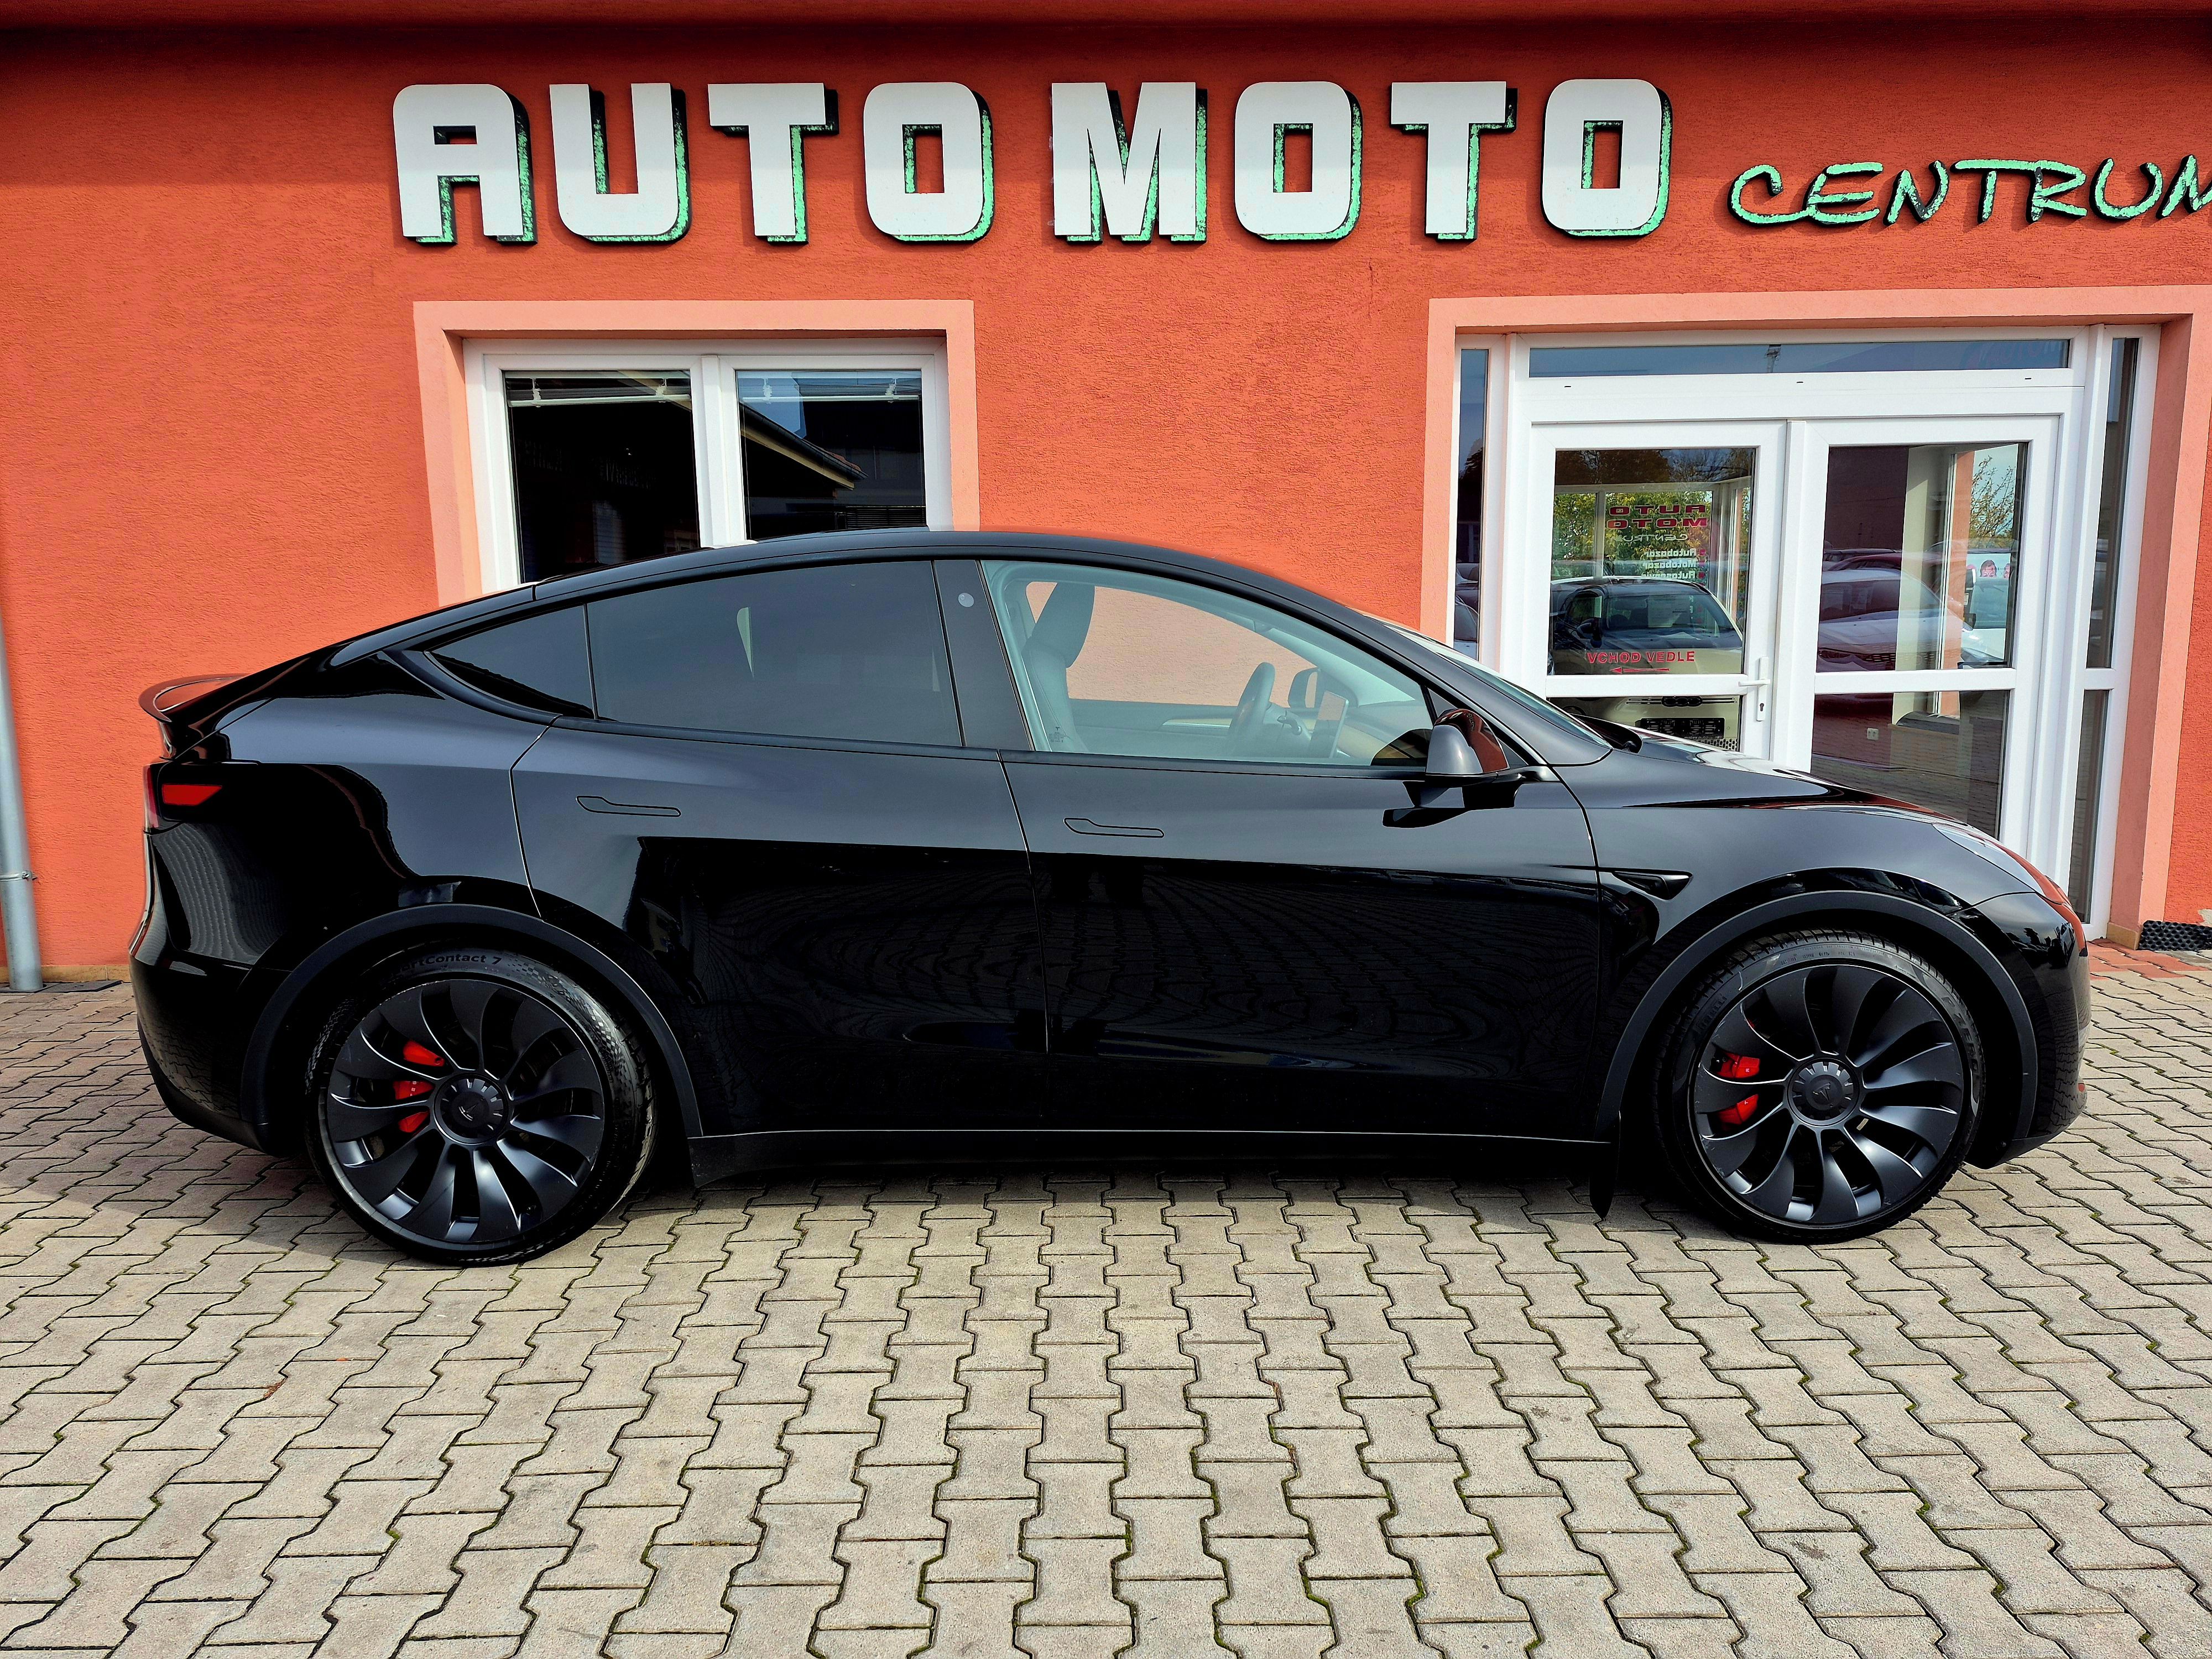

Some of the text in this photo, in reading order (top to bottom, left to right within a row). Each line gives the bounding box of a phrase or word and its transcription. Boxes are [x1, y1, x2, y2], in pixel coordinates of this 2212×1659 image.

[393, 81, 994, 245] AUTO
[1051, 79, 1673, 244] MOTO
[1587, 651, 1695, 664] VCHOD VEDLE
[492, 956, 502, 964] 7
